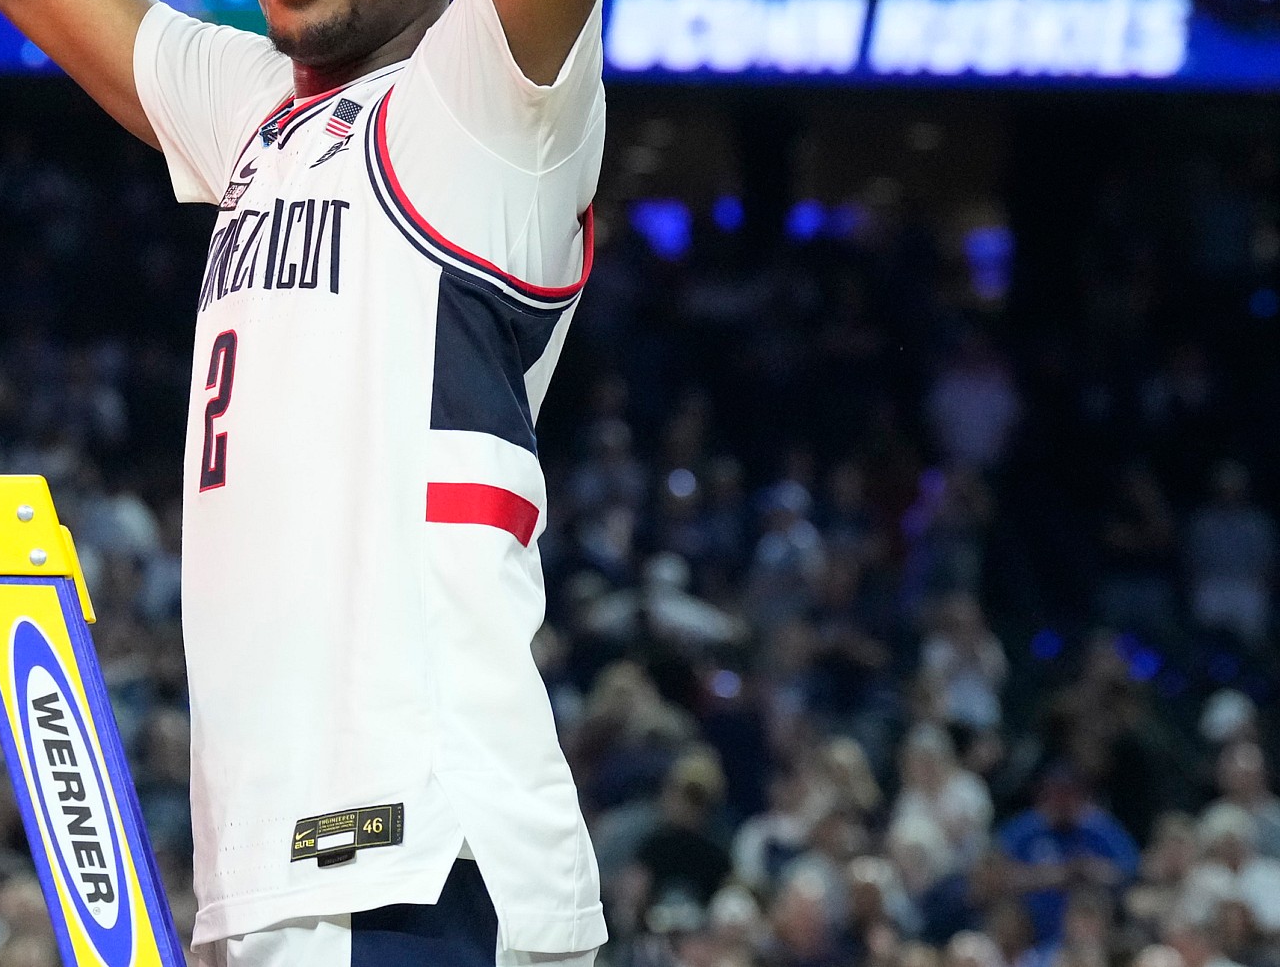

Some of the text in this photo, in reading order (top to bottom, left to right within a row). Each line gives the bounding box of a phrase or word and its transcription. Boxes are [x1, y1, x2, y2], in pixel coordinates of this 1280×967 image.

[199, 329, 238, 493] 2
[32, 692, 115, 904] WERNER
[363, 817, 383, 833] 46
